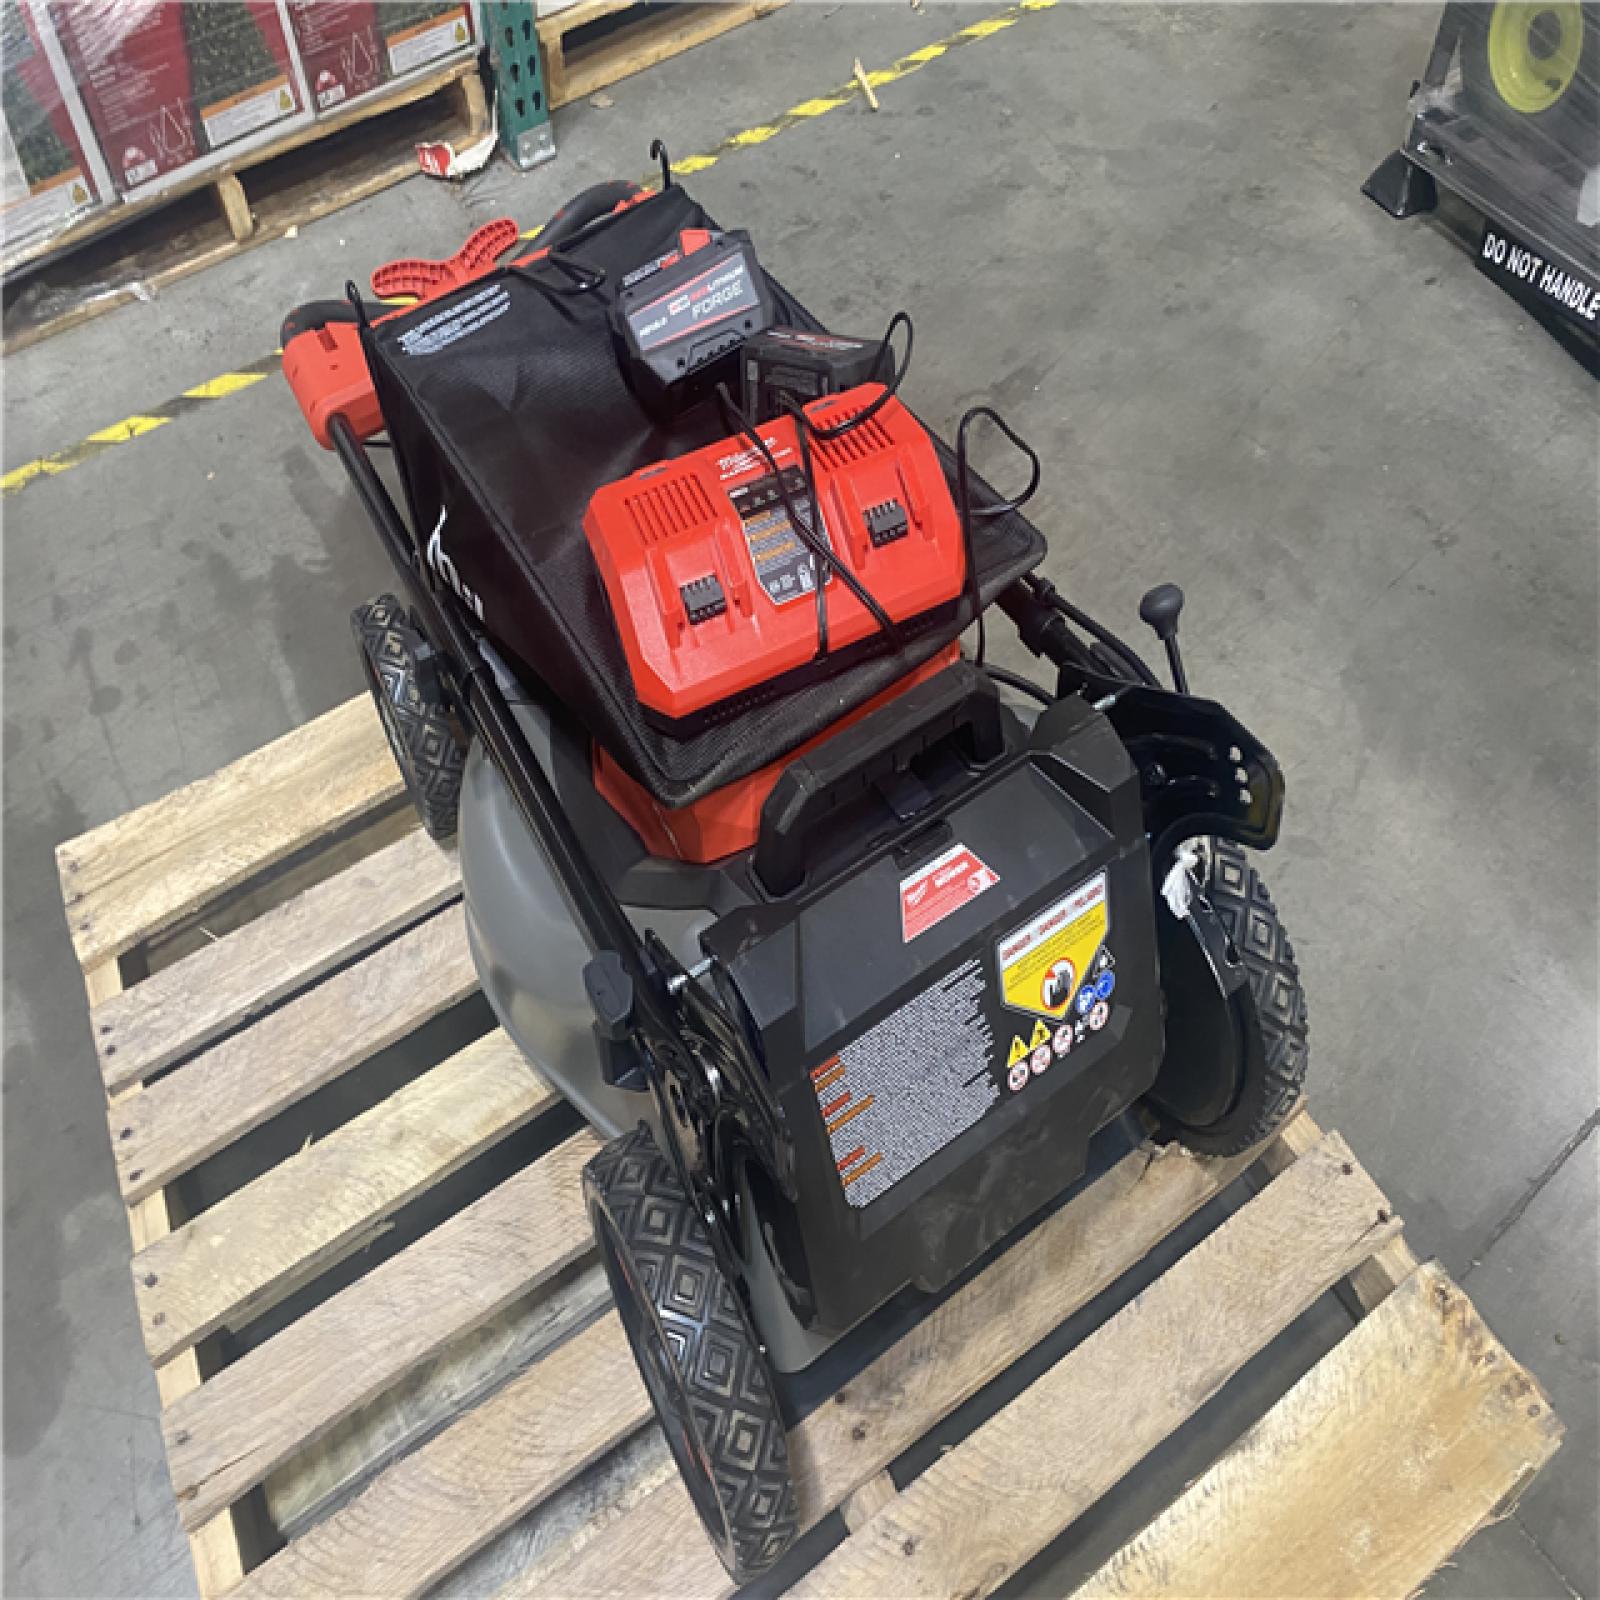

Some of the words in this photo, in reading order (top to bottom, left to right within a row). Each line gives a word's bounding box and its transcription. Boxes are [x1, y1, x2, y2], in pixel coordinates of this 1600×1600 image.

[691, 279, 743, 320] FORGE
[1482, 232, 1506, 264] DO
[1505, 246, 1543, 283] NOT
[1540, 265, 1600, 320] HANDLE
